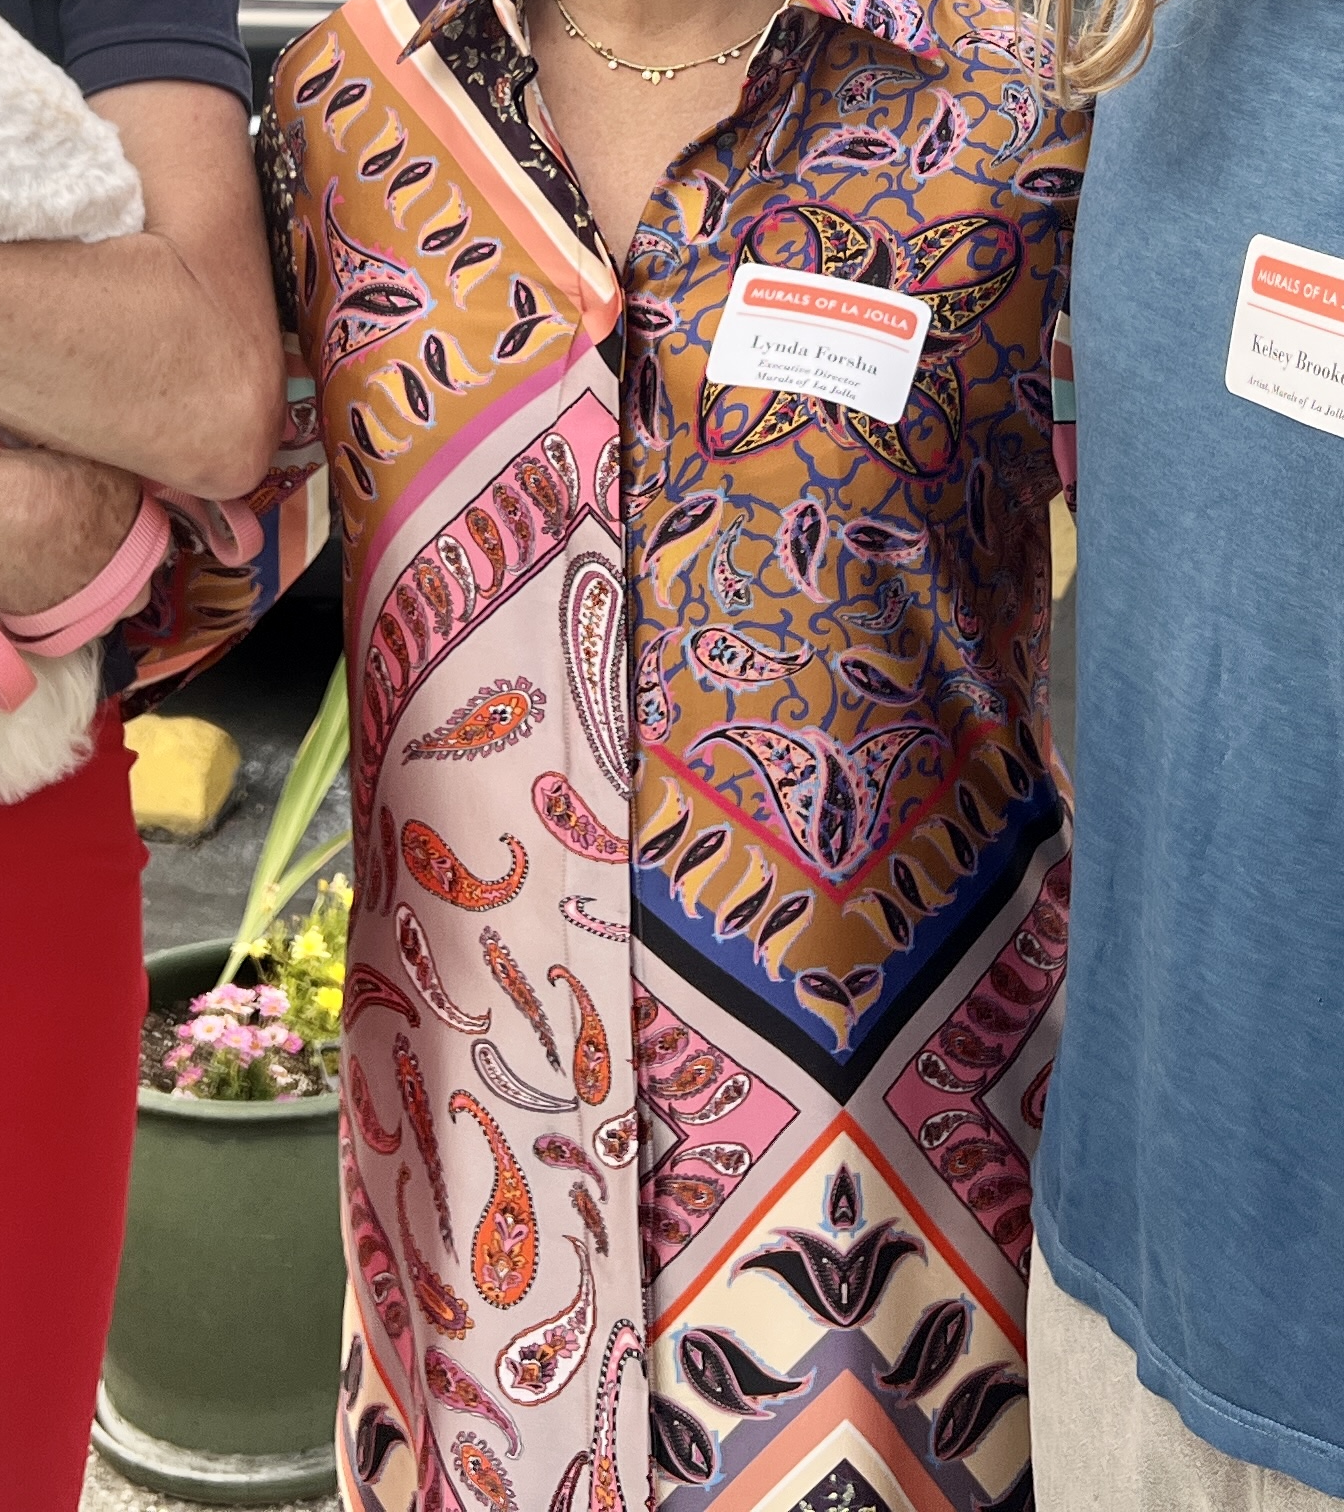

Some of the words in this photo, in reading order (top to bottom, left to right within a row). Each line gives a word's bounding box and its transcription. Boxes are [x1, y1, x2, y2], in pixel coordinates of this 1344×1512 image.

[1258, 270, 1300, 293] MURALS
[1303, 283, 1321, 300] OF
[1322, 290, 1338, 307] LA
[751, 289, 810, 305] MURALS
[814, 297, 838, 310] OF
[841, 303, 860, 316] LA
[864, 309, 908, 330] JOLLA
[751, 335, 808, 355] Lynda
[815, 346, 878, 375] Forsha
[1252, 334, 1292, 370] Kelsey
[756, 370, 794, 385] Murals
[795, 377, 809, 389] of
[812, 380, 827, 392] La
[829, 385, 857, 401] Jolla
[757, 358, 811, 374] Executive
[813, 368, 862, 387] Director
[1270, 383, 1299, 404] Murals
[1298, 396, 1310, 410] of
[1310, 399, 1323, 413] La
